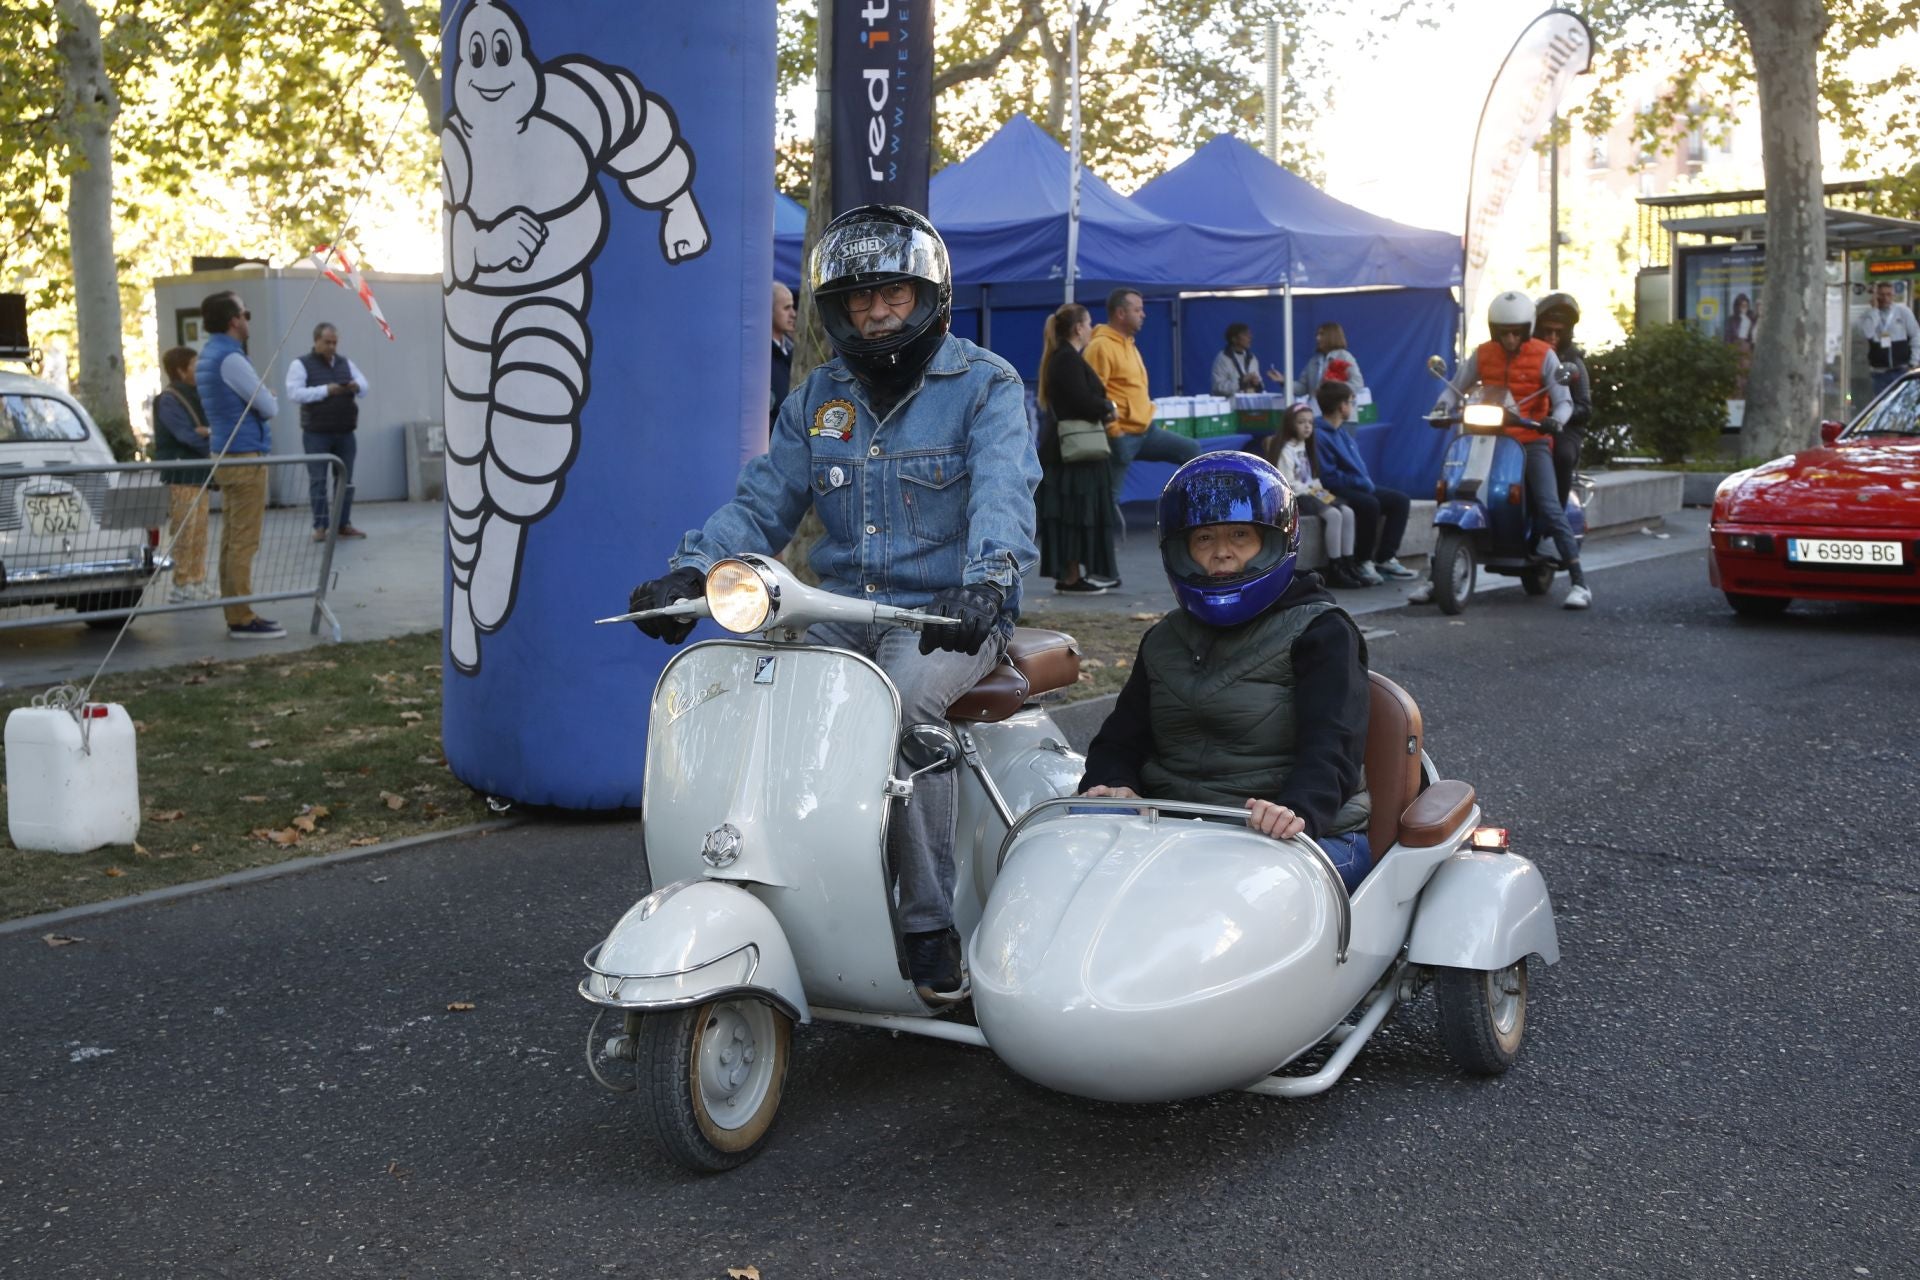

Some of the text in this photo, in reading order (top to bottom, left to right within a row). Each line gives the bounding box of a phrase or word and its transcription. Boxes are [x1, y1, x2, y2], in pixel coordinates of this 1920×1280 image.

[888, 0, 910, 182] WWW.ITEVE
[842, 239, 880, 258] SHOEI
[1800, 542, 1895, 561] V 6999 BG
